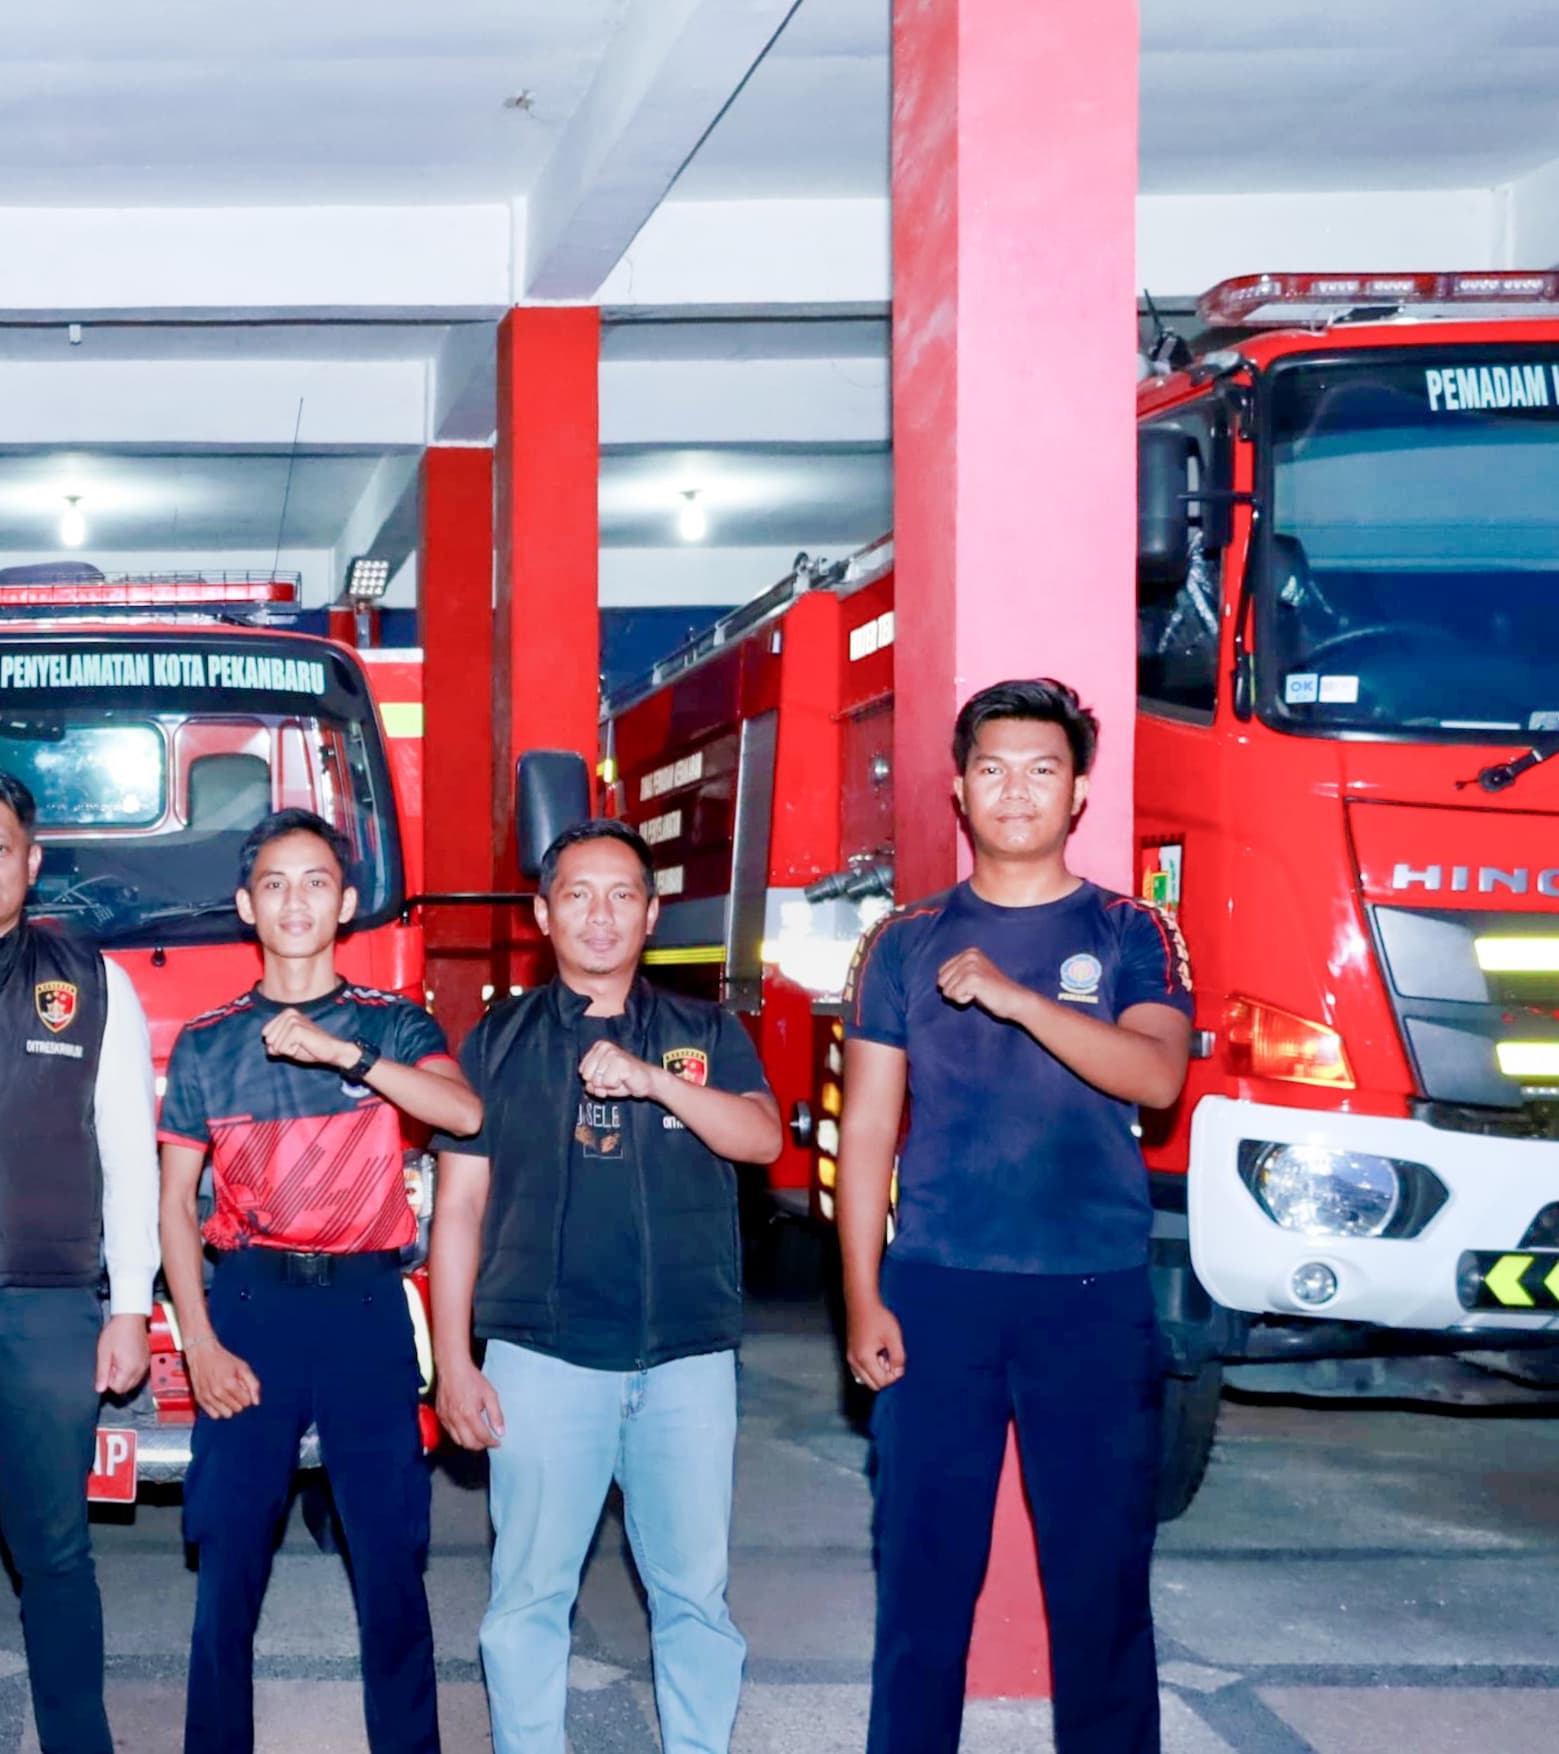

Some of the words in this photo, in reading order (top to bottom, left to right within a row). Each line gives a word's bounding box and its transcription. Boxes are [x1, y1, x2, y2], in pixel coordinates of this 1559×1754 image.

[1425, 365, 1549, 411] PEMADAM
[0, 654, 150, 688] PENYELAMATAN
[153, 654, 205, 686] KOTA
[208, 655, 325, 695] PEKANBARU
